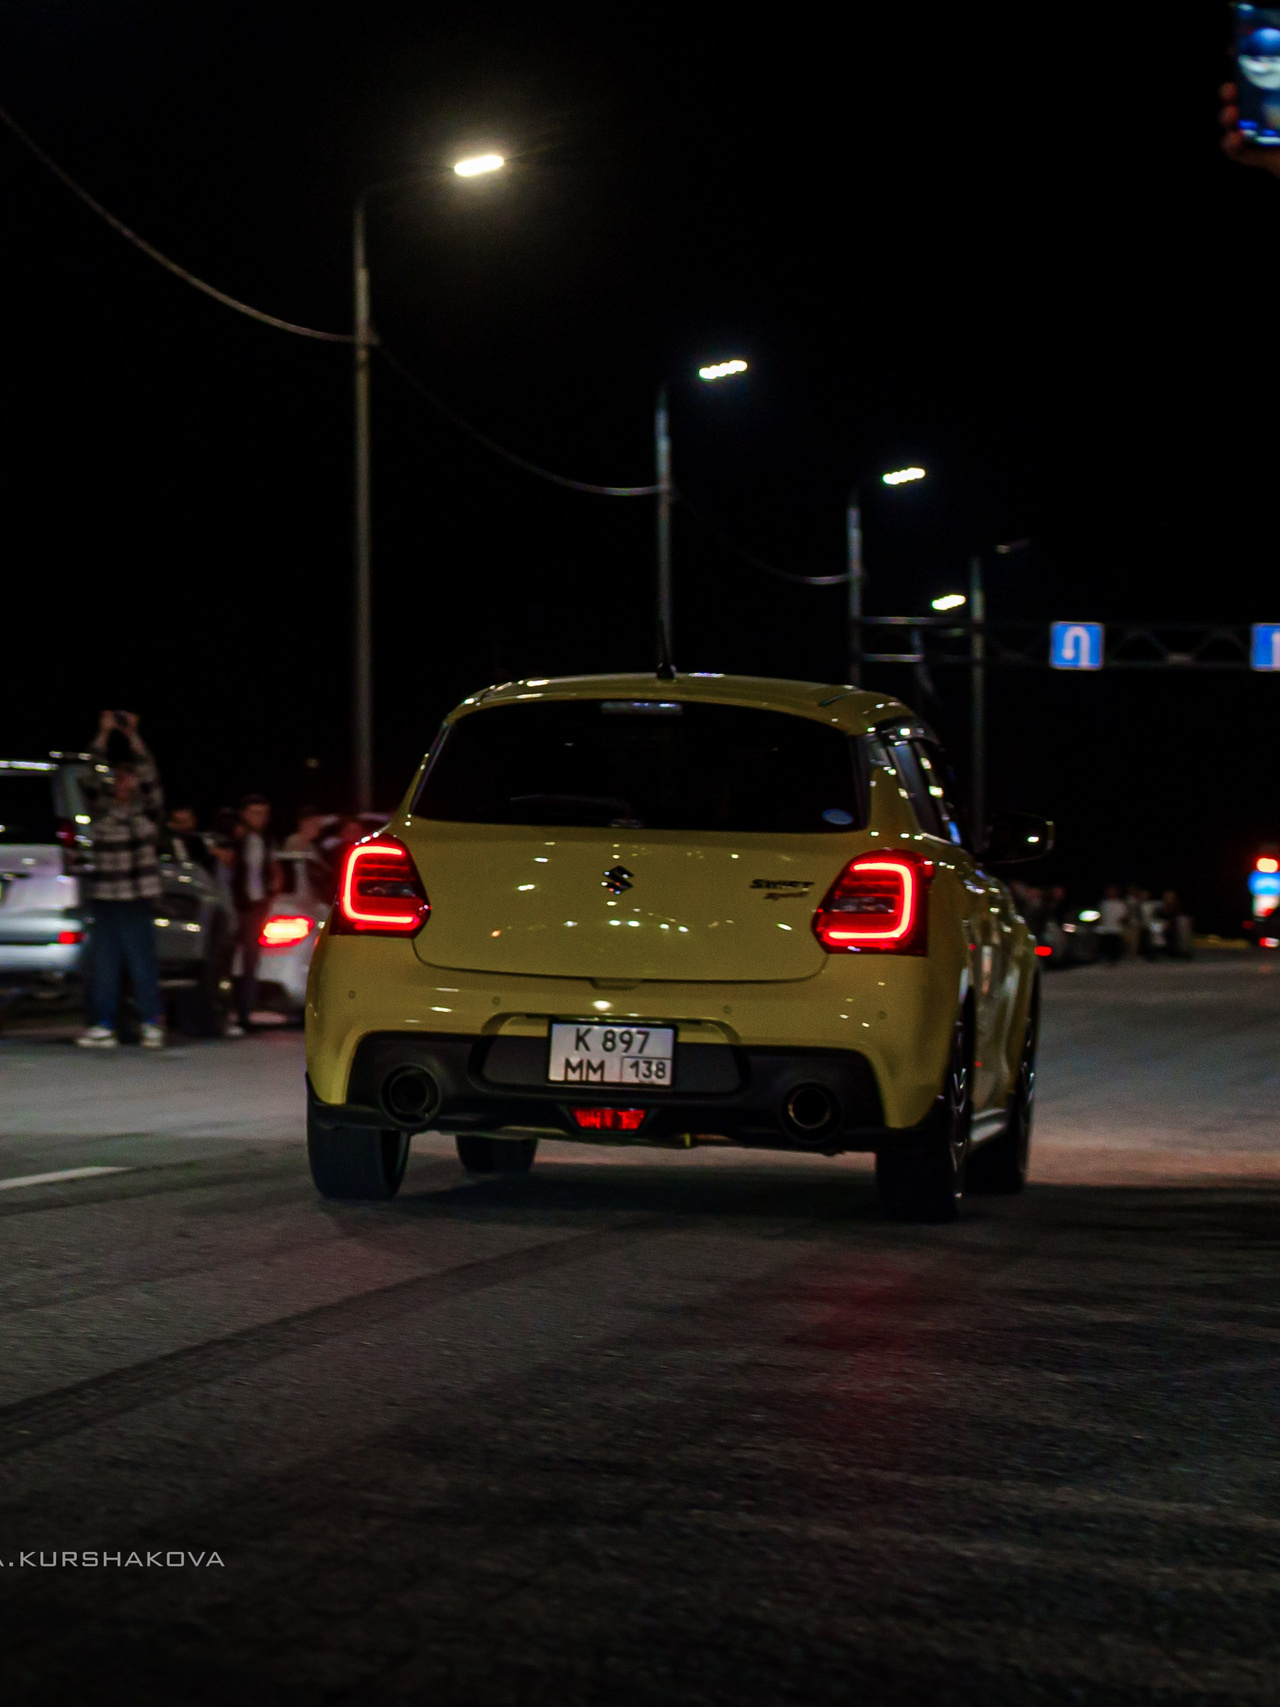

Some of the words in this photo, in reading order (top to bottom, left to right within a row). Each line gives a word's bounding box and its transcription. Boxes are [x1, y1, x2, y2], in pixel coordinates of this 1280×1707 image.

[601, 1029, 650, 1054] 897
[564, 1058, 605, 1082] MM
[629, 1060, 666, 1079] 138
